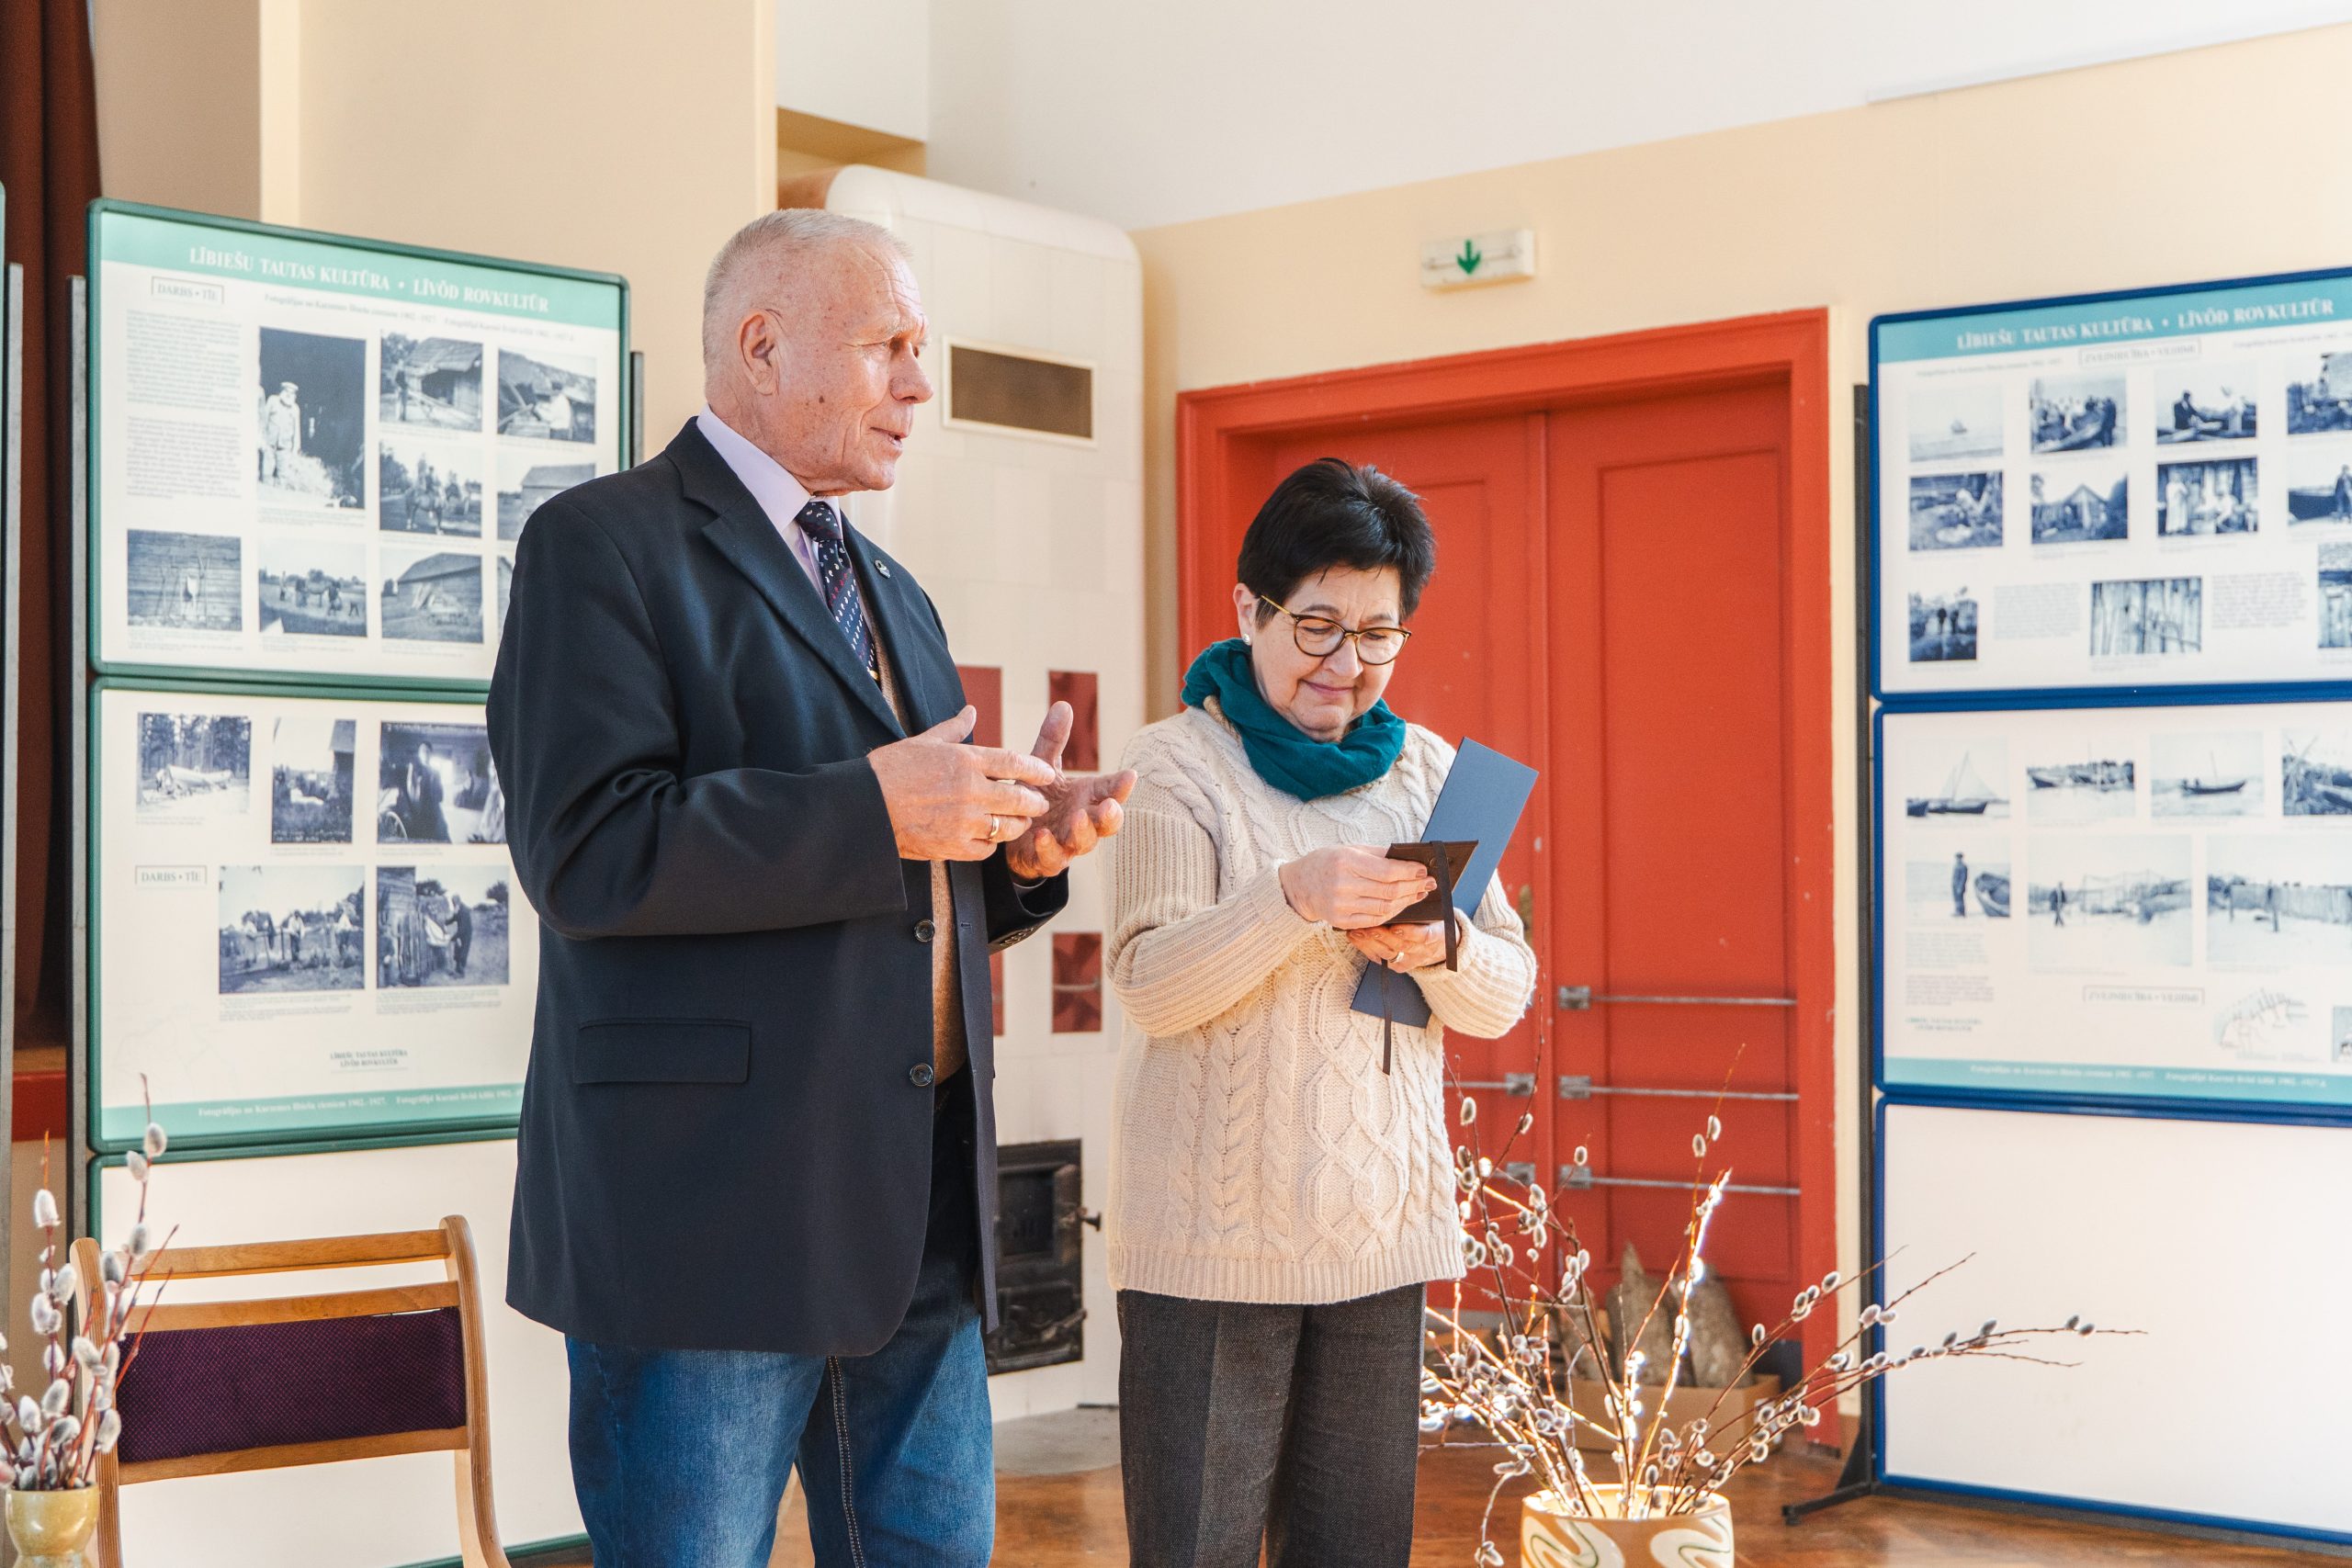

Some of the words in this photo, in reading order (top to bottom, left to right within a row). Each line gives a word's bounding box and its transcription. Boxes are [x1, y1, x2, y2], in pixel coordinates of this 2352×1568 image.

[157, 283, 194, 297] DARBS
[189, 246, 254, 273] LĪBIEŠU
[260, 258, 316, 281] TAUTAS
[320, 266, 390, 291] KULTŪRA
[463, 288, 549, 313] ROVKULTŪR
[1957, 329, 2015, 350] LĪBIEŠU
[2023, 324, 2076, 344] TAUTAS
[2080, 316, 2154, 339] KULTŪRA
[2233, 298, 2334, 323] ROVKULTŪR
[141, 872, 177, 883] DARBS
